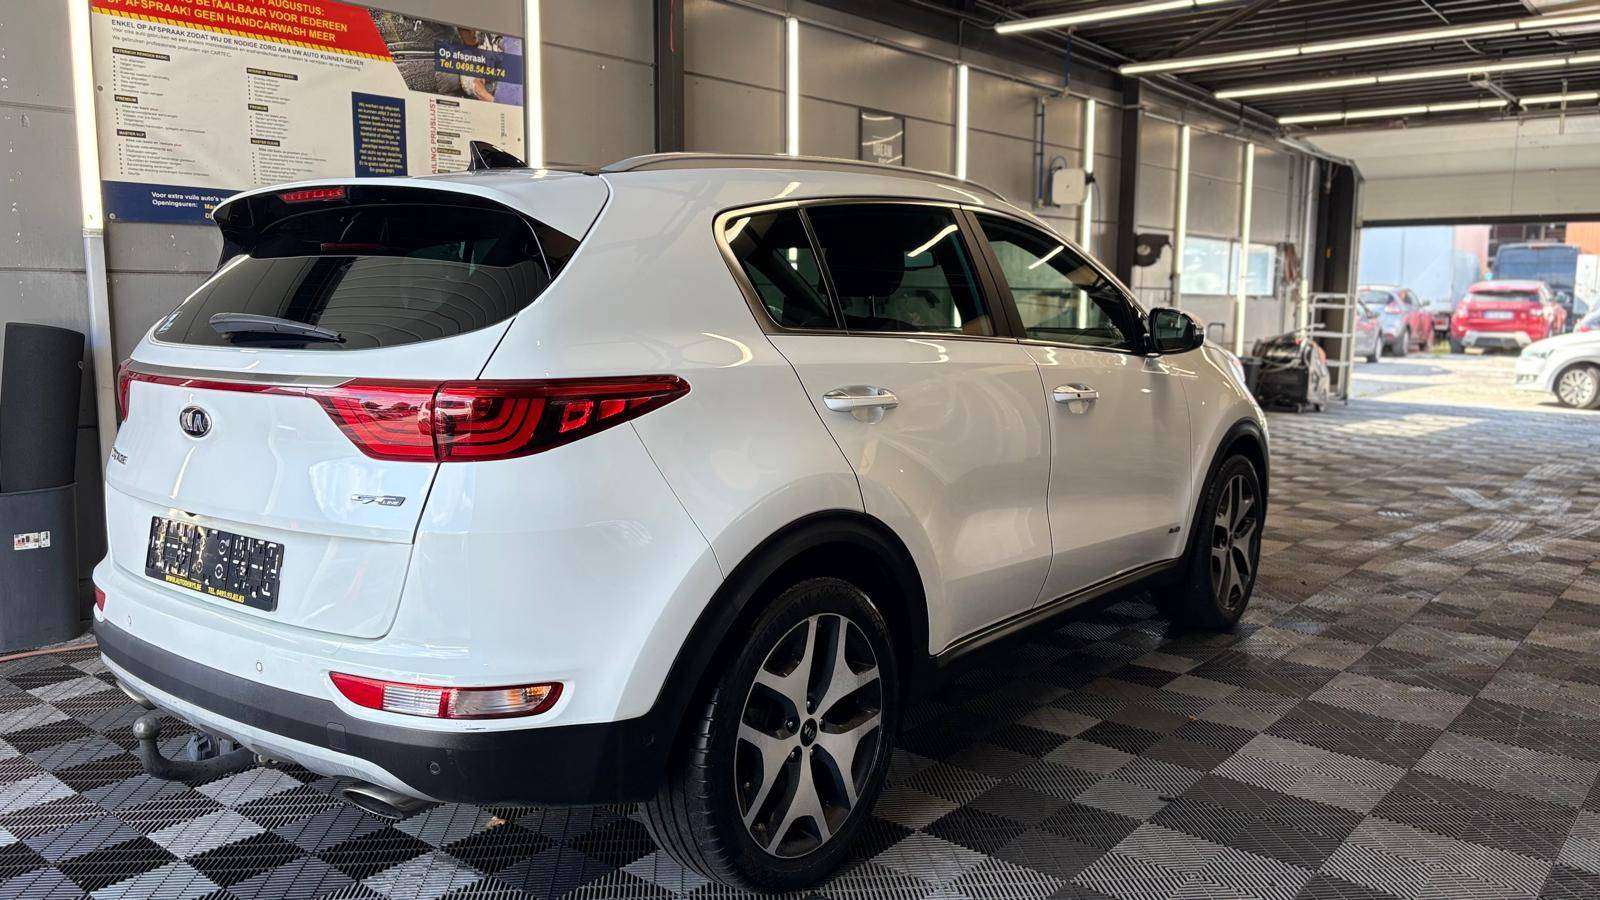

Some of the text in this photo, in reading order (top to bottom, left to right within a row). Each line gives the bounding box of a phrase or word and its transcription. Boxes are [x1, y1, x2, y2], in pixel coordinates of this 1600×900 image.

[195, 0, 348, 32] BETAALBAAR VOOR IEDEREEN
[267, 0, 325, 15] AUGUSTUS:
[125, 0, 191, 16] AFSPRAAK!
[194, 10, 223, 23] GEEN
[227, 14, 307, 37] HANDCARWASH
[309, 30, 336, 42] MEER
[112, 19, 136, 29] ENKEL
[148, 24, 185, 37] AFSPRAAK
[186, 31, 208, 41] ZODAT
[210, 35, 222, 43] WIJ
[260, 43, 277, 52] ZORG
[278, 46, 291, 54] AAN
[292, 48, 301, 56] UW
[303, 51, 319, 59] AUTO
[320, 54, 344, 63] KUNNEN
[345, 57, 364, 67] GEVEN
[439, 48, 487, 63] Op afspraak
[440, 58, 506, 78] Tel. 0498.54.54.74
[151, 191, 167, 199] Voor
[200, 194, 219, 202] auto's
